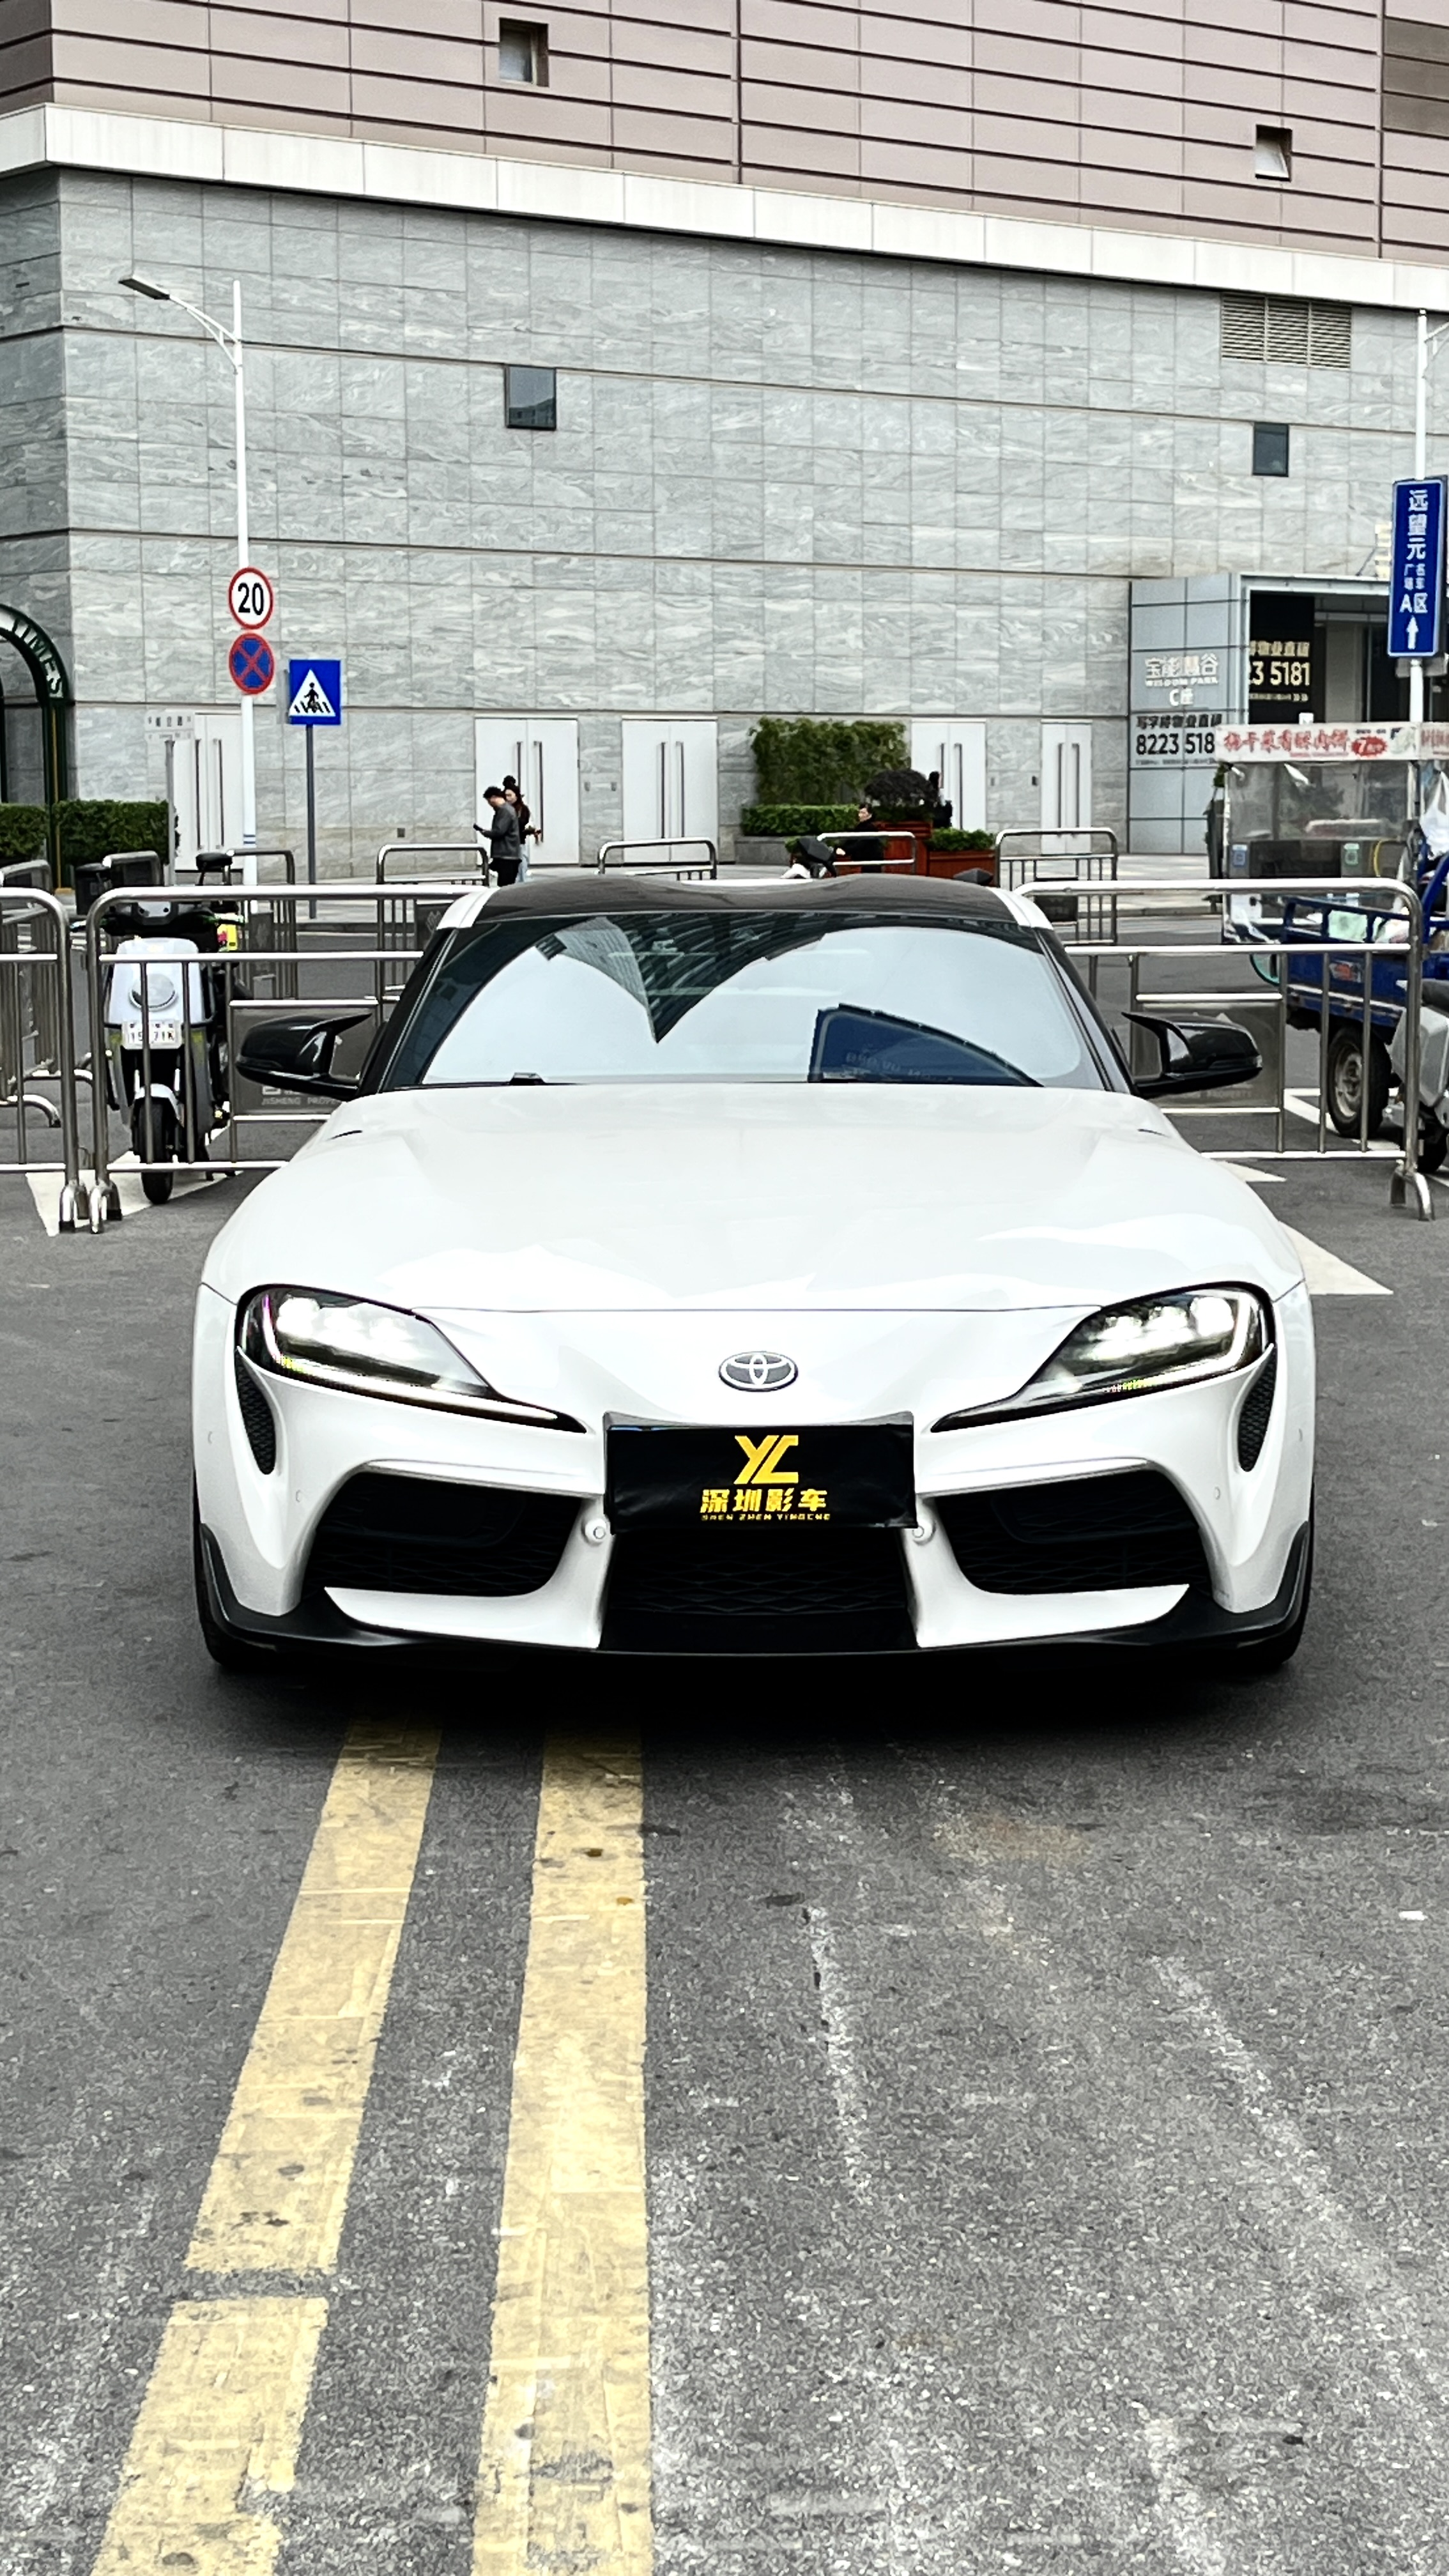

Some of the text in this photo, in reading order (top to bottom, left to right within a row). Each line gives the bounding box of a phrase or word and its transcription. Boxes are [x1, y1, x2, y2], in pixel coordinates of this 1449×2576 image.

[238, 582, 264, 616] 20
[1399, 592, 1429, 613] A区
[1190, 676, 1218, 686] PARK
[1269, 661, 1310, 686] 5181
[1136, 733, 1179, 756] 8223
[700, 1488, 827, 1513] 深圳影车
